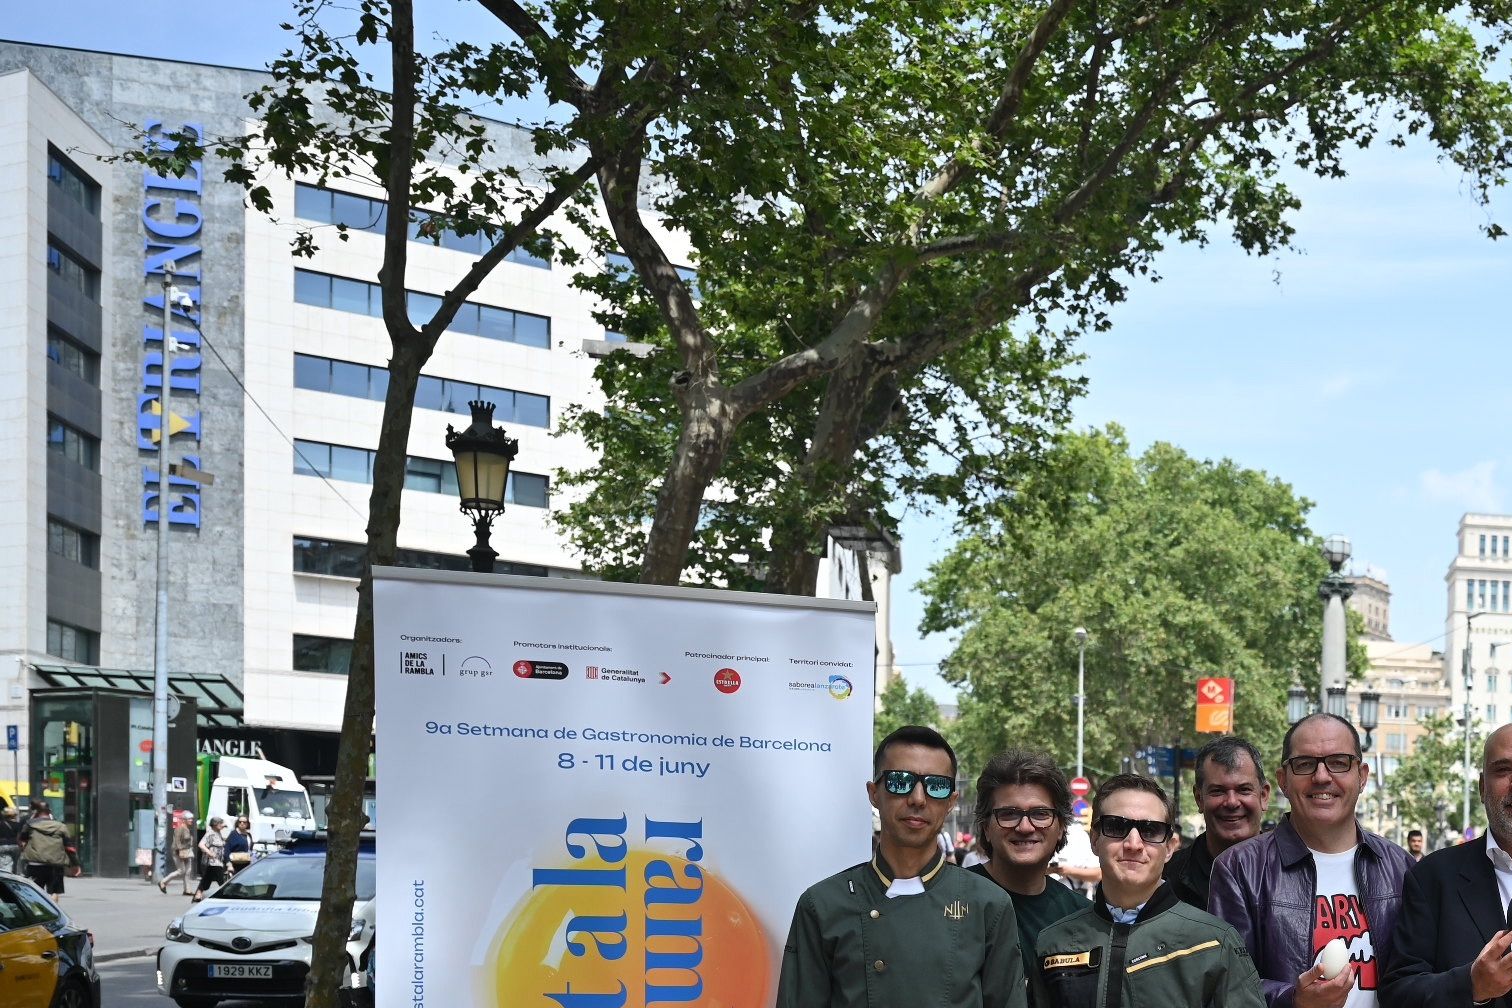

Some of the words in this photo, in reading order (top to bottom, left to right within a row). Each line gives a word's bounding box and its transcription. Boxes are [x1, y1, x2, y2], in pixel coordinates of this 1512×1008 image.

[400, 634, 463, 644] Organitzadors:
[513, 640, 557, 650] Promotors
[558, 643, 613, 653] institucionals:
[404, 652, 428, 661] AMICS
[684, 651, 735, 661] Patrocinador
[404, 660, 414, 668] DE
[416, 660, 425, 669] LA
[789, 658, 818, 666] Territori
[819, 660, 854, 668] convidat:
[404, 667, 435, 676] RAMBLA
[459, 669, 478, 678] grup
[480, 670, 494, 678] gsr
[535, 668, 563, 676] Barcelona
[601, 667, 640, 677] Generalitat
[611, 675, 646, 684] Catalunya
[425, 721, 452, 735] 9a
[456, 722, 549, 739] Setmana
[553, 725, 578, 740] de
[581, 727, 708, 747] Gastronomia
[712, 733, 735, 748] de
[739, 736, 832, 752] Barcelona
[557, 752, 575, 770] 8
[595, 754, 615, 771] 11
[621, 754, 653, 774] de
[659, 757, 711, 778] juny
[532, 811, 628, 894] la
[565, 908, 628, 961] a
[217, 966, 245, 976] 1929
[248, 966, 271, 977] KKZ
